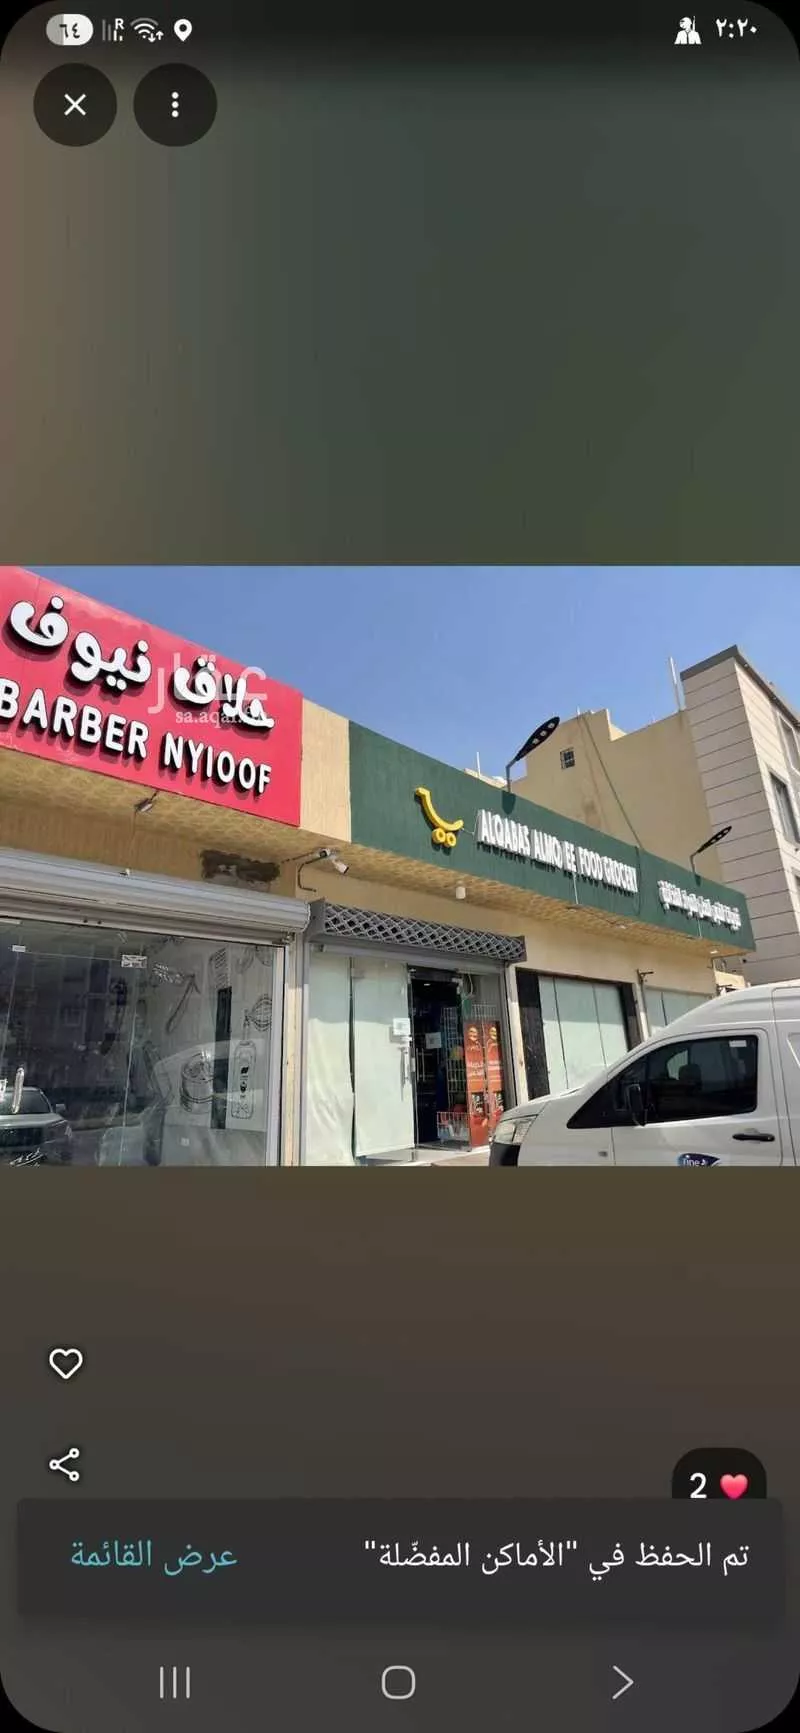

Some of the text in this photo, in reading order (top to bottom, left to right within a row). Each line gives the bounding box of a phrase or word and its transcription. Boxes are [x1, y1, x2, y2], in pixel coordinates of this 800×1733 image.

[9, 595, 275, 728] حلاق نيوف
[0, 677, 273, 794] BARBER NYIOOF
[479, 808, 531, 857] ALQABAS
[577, 846, 604, 881] FOOD
